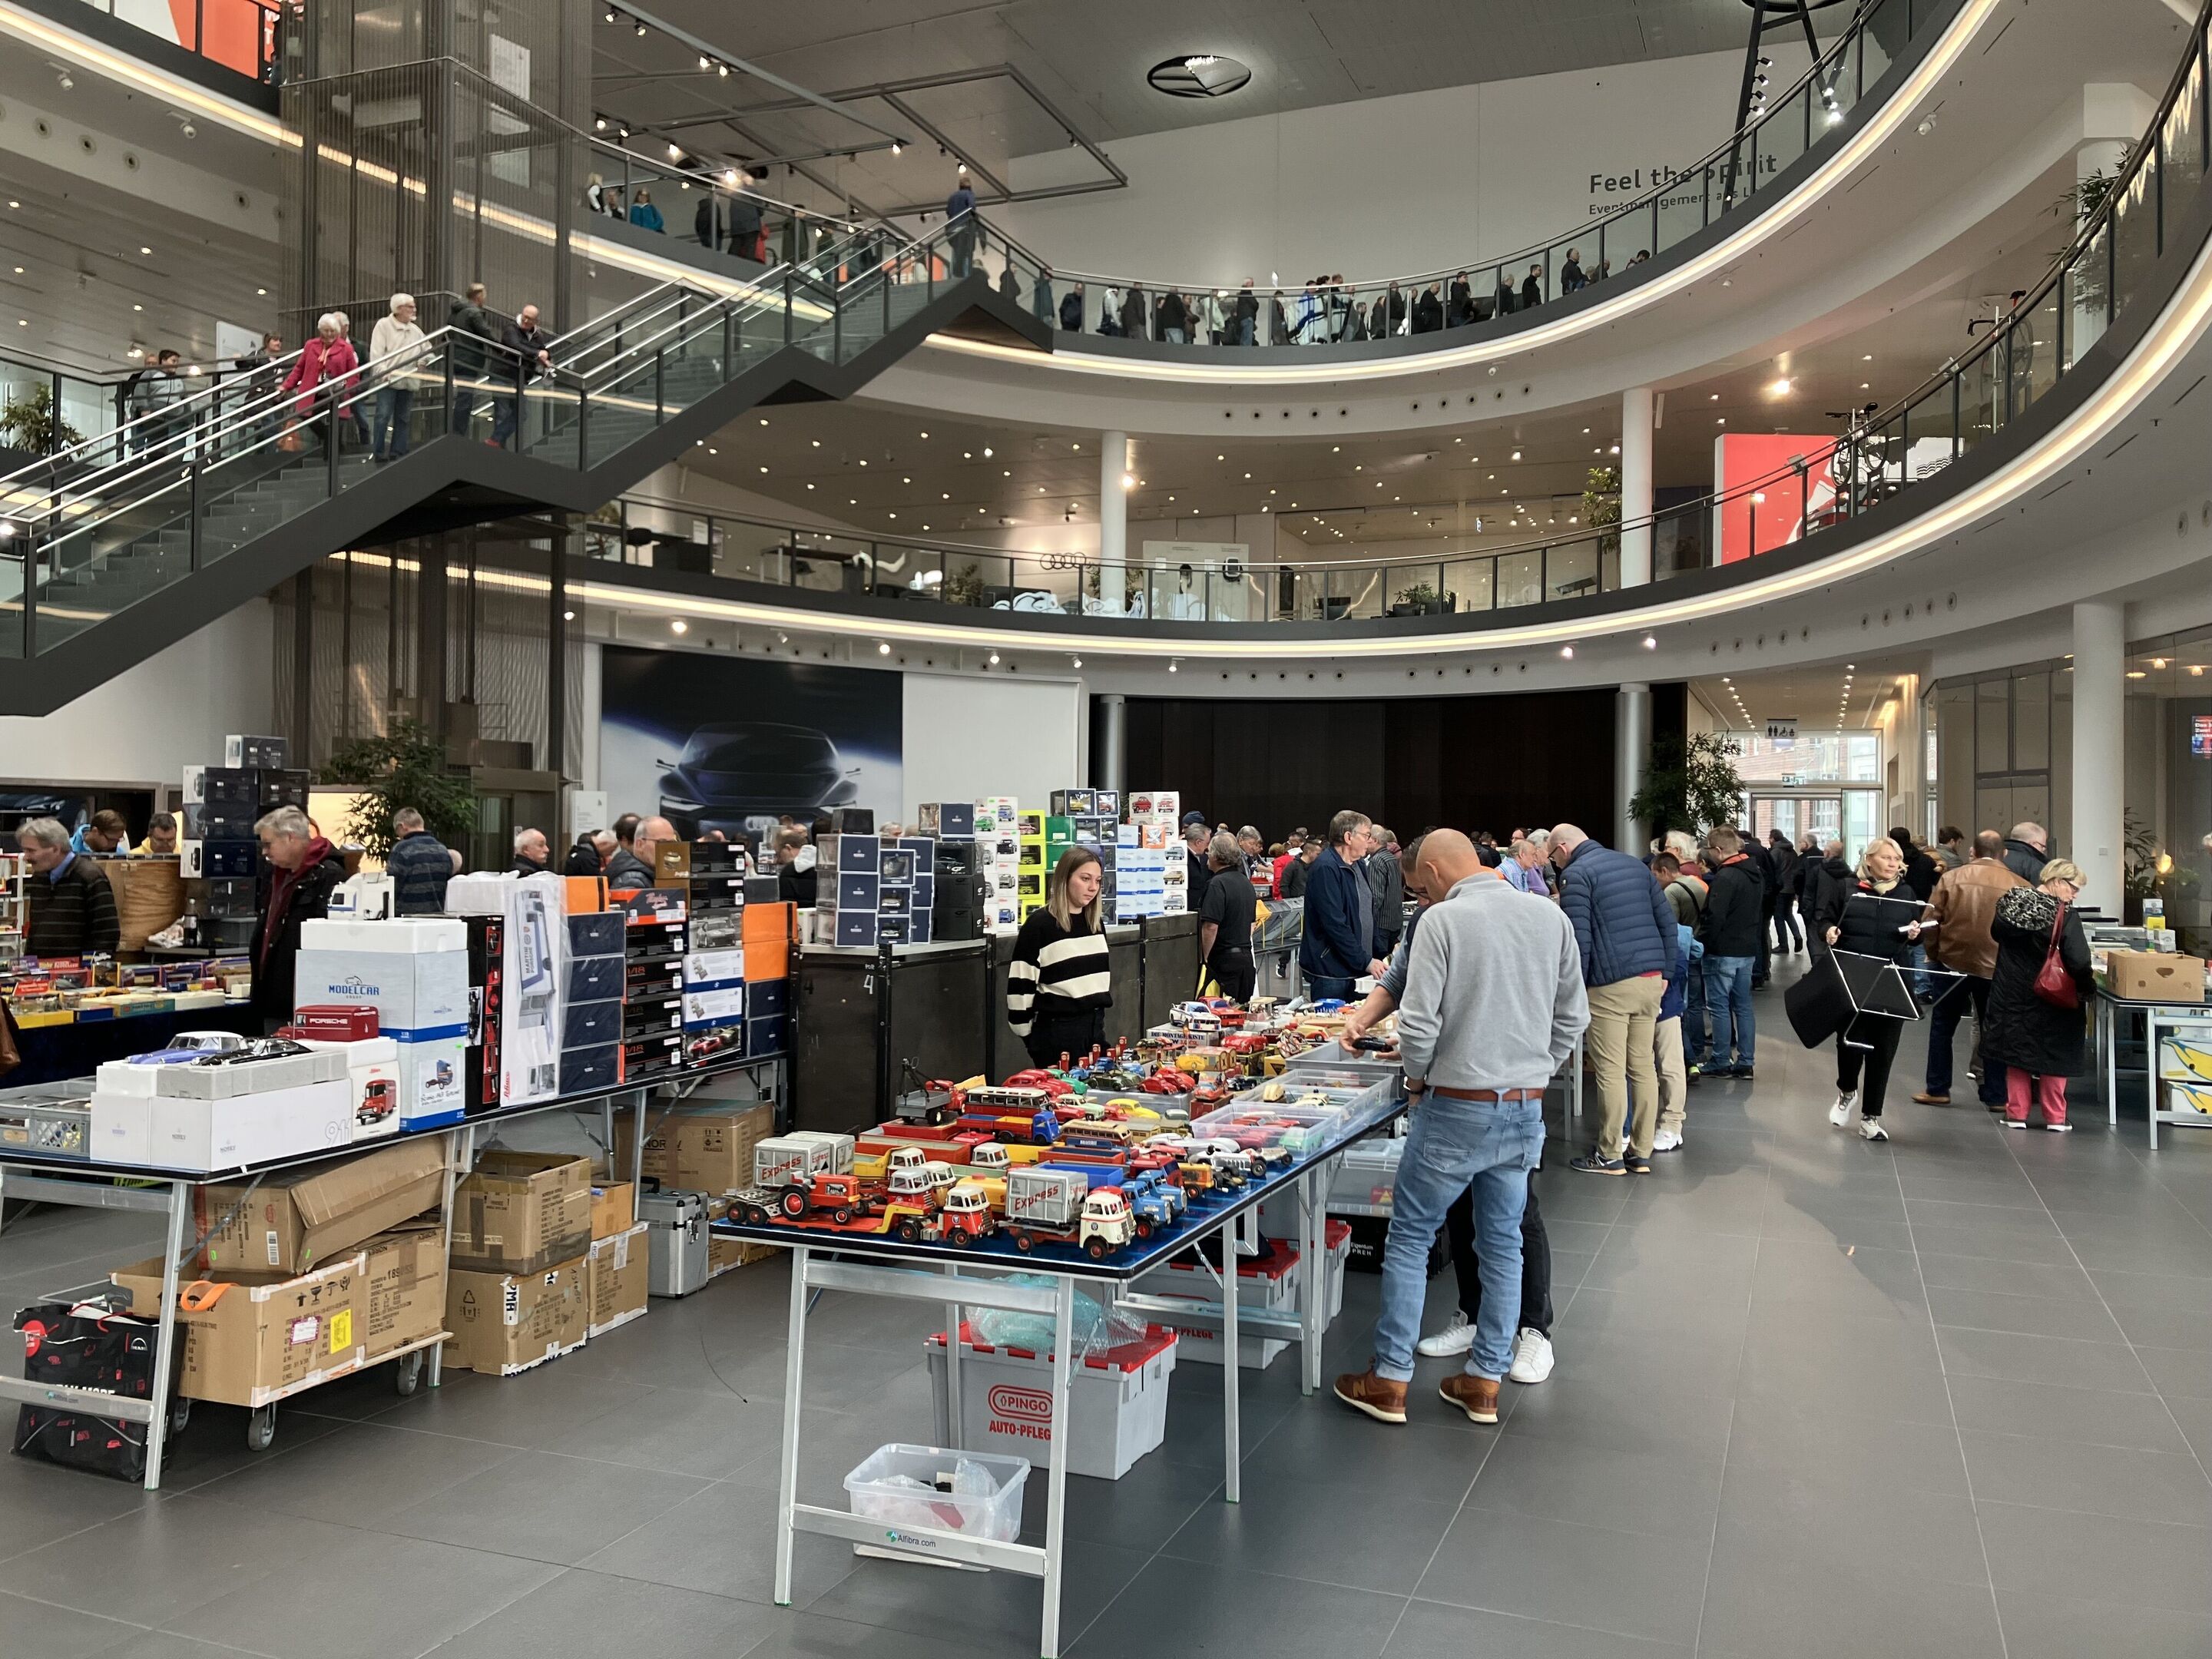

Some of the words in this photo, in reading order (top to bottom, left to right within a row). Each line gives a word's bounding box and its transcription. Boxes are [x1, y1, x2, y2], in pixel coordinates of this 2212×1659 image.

[1590, 169, 1641, 194] Feel
[1651, 165, 1693, 187] the
[1716, 190, 1739, 201] as
[328, 985, 380, 996] MODELCAR
[863, 974, 874, 995] 4
[1162, 1032, 1205, 1041] MONTAGKISTE
[761, 1155, 802, 1181] Express
[1014, 1185, 1058, 1211] Express
[1008, 1396, 1048, 1412] PINGO
[988, 1419, 1051, 1441] AUTO-PFLEG
[897, 1535, 936, 1548] Alfibra.com
